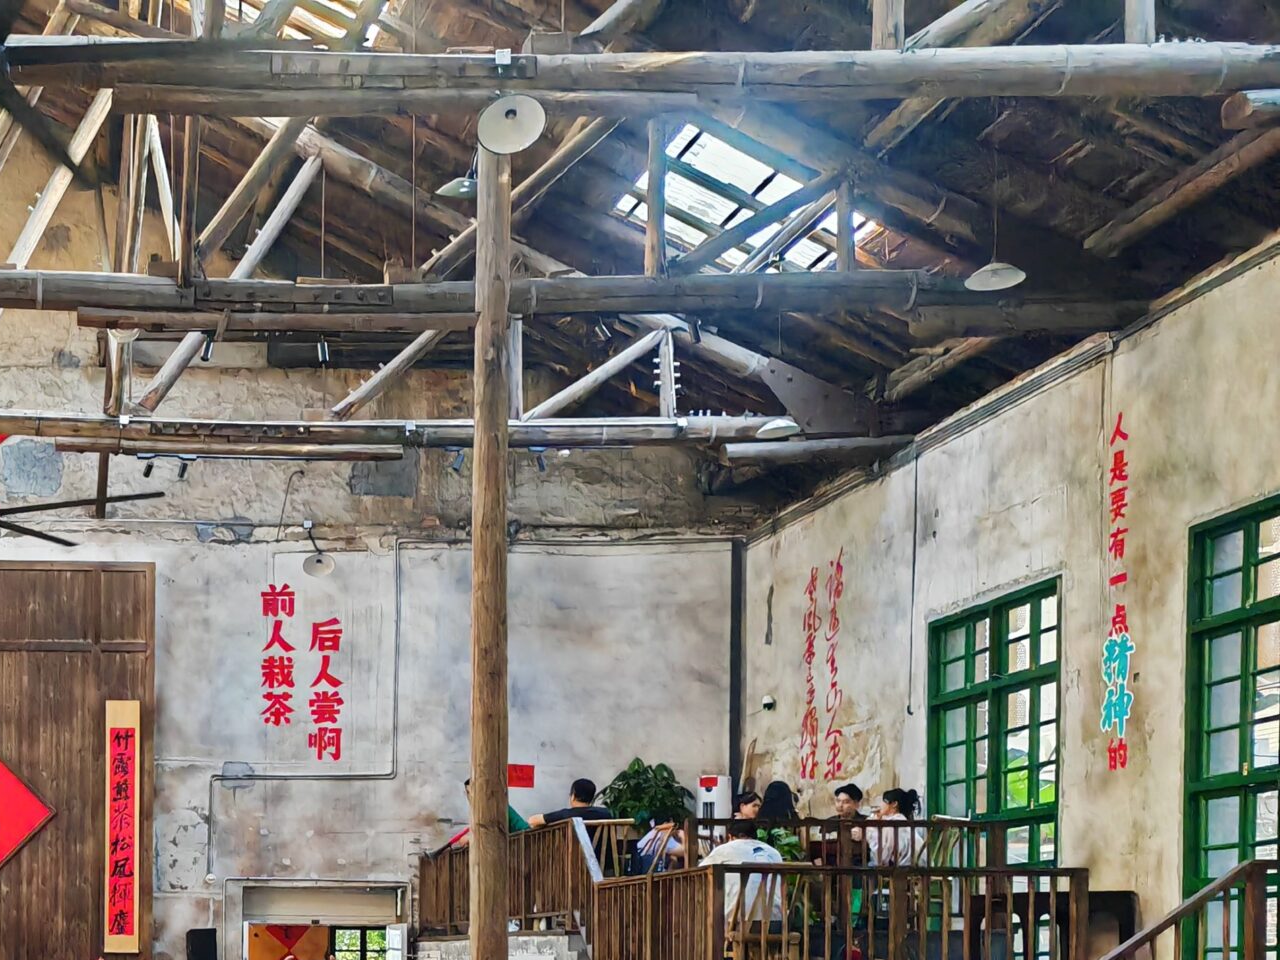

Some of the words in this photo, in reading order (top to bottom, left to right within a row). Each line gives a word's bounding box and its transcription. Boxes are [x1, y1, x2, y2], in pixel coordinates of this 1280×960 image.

[260, 583, 296, 726] 前人栽茶
[1100, 411, 1135, 771] 人是要有一点精神的
[308, 617, 344, 760] 后人尝啊
